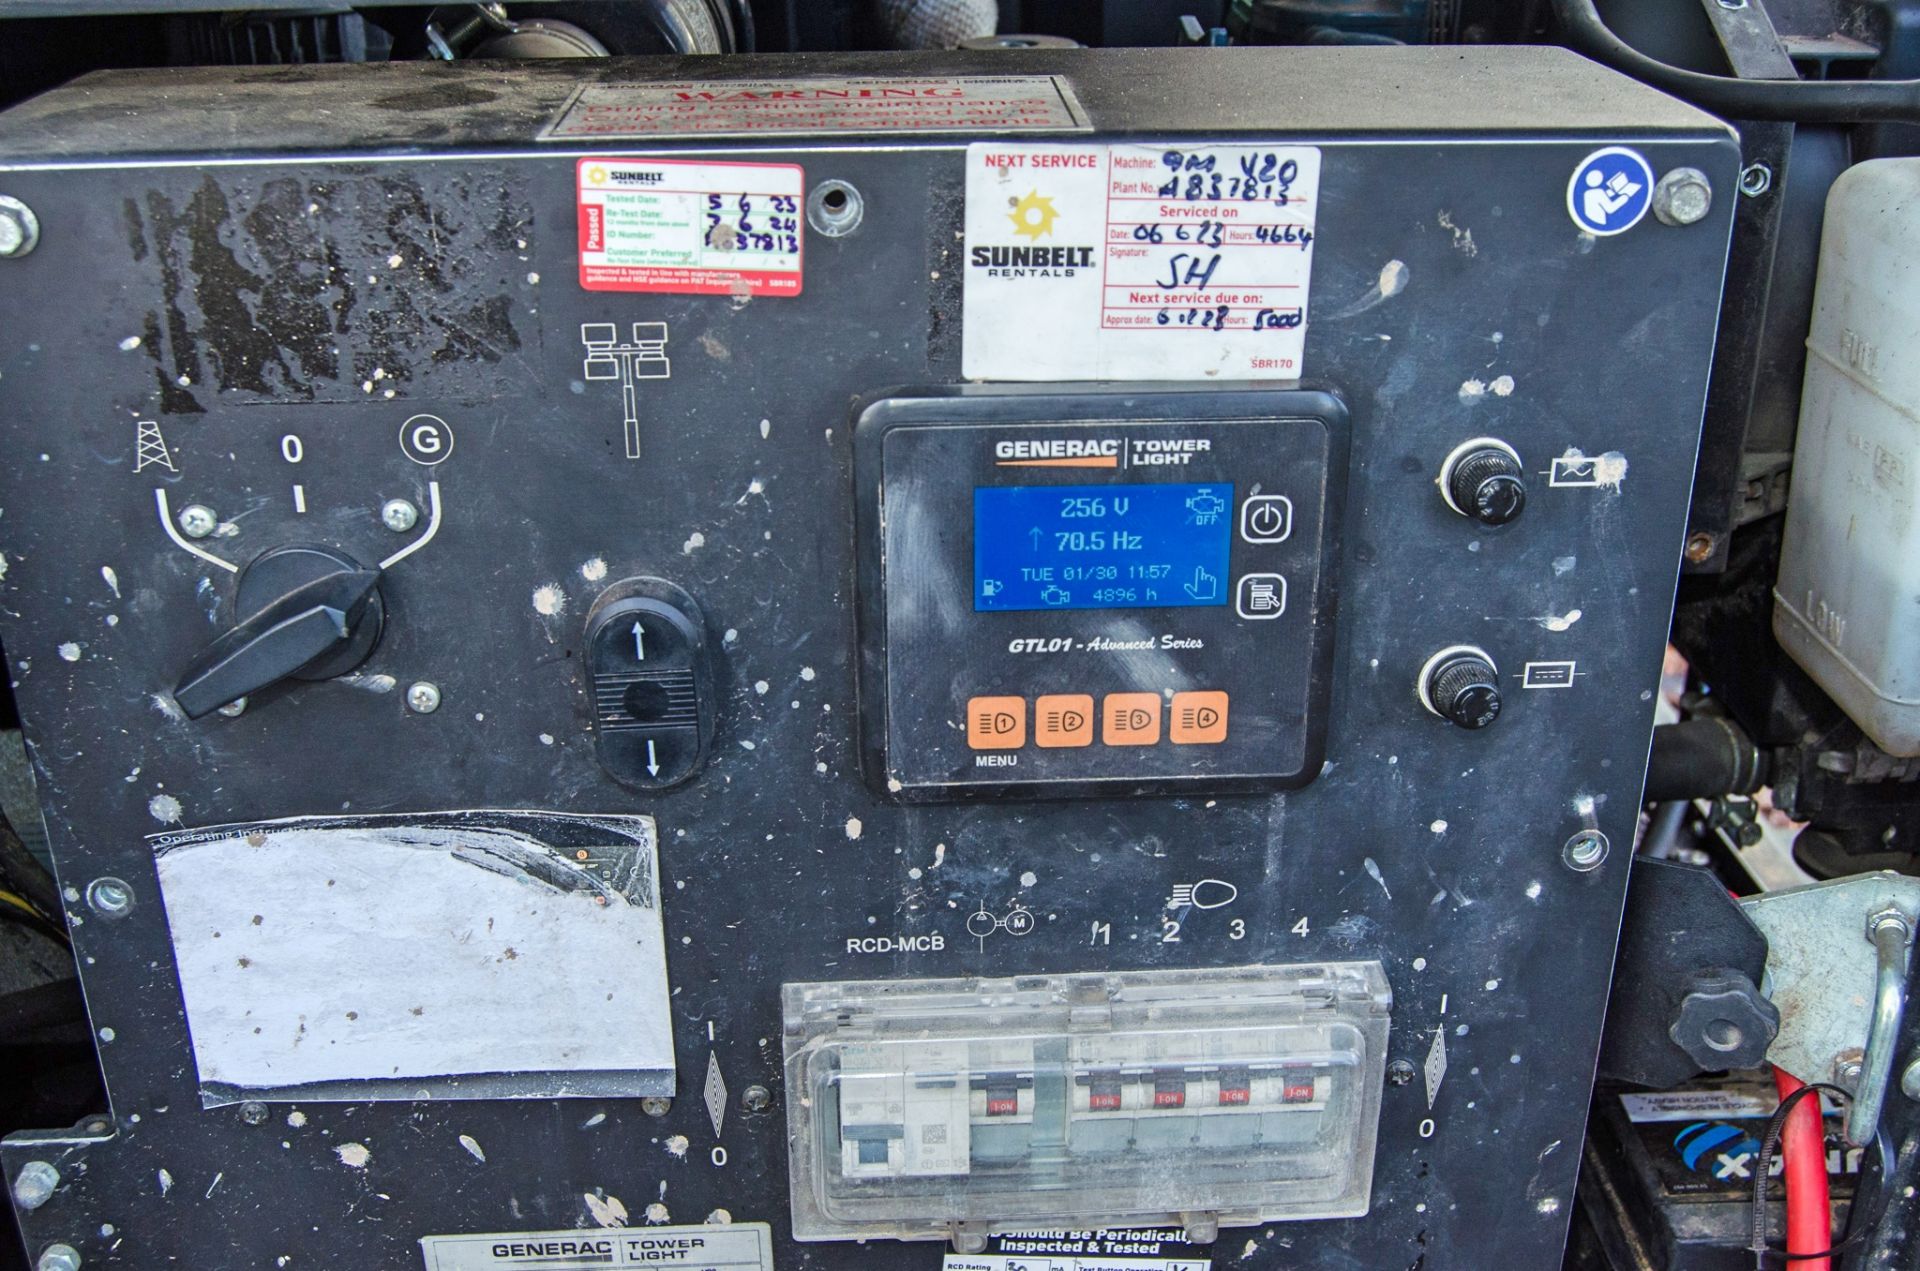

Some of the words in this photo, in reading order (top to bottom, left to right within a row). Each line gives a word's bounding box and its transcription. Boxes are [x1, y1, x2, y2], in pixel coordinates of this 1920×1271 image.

[673, 88, 963, 102] WARNING
[984, 155, 1027, 168] NEXT
[1031, 155, 1097, 168] SERVICE
[1113, 156, 1156, 169] Machine:
[611, 171, 663, 182] SUNBELT
[1112, 181, 1143, 194] Plant
[606, 194, 636, 204] Tested
[637, 195, 661, 204] Date:
[606, 208, 638, 218] Re-Test
[640, 209, 663, 218] Date:
[1160, 205, 1215, 219] Serviced
[1225, 207, 1239, 218] on
[587, 207, 600, 250] Passed
[1110, 229, 1131, 241] Date:
[1229, 229, 1254, 241] Hours:
[606, 247, 648, 257] Customer
[650, 249, 693, 258] Preferred
[971, 247, 1093, 268] SUNBELT
[1109, 247, 1149, 259] Signature:
[988, 268, 1076, 278] RENTALS
[1129, 292, 1160, 304] Next
[1163, 293, 1211, 304] service
[1215, 292, 1238, 304] due
[1243, 293, 1263, 304] on:
[1106, 314, 1132, 327] Approx
[1134, 314, 1153, 325] date:
[1252, 358, 1293, 369] SBR170
[411, 425, 442, 454] G
[1133, 438, 1211, 453] TOWER
[996, 439, 1119, 458] GENERAC
[1132, 452, 1193, 466] LIGHT
[1061, 497, 1106, 518] 256
[1114, 496, 1130, 517] V
[1195, 514, 1219, 526] OFF
[1055, 530, 1105, 552] 70.5
[1112, 530, 1143, 551] Hz
[1020, 567, 1054, 582] TUE
[1063, 566, 1118, 582] 01/30
[1127, 564, 1171, 579] 11:57
[1092, 587, 1137, 602] 4896
[1146, 587, 1157, 601] h
[1008, 637, 1073, 653] GTL01
[1086, 635, 1156, 653] Advanced
[1160, 634, 1204, 650] Series
[999, 716, 1007, 729] 1
[1068, 716, 1076, 728] 2
[1136, 714, 1143, 726] 3
[1202, 711, 1211, 724] 4
[975, 755, 1018, 768] MENU
[158, 831, 234, 845] Operating
[1013, 918, 1025, 929] M
[1098, 923, 1111, 945] 1
[1162, 920, 1181, 943] 2
[1229, 919, 1246, 941] 3
[1291, 916, 1310, 938] 4
[846, 935, 945, 954] RCD-MCB
[492, 1241, 612, 1258] GENERAC
[629, 1238, 705, 1251] TOWER
[999, 1239, 1083, 1254] Inspected
[1086, 1241, 1100, 1253] &
[1104, 1241, 1161, 1254] Tested
[629, 1249, 688, 1261] LIGHT
